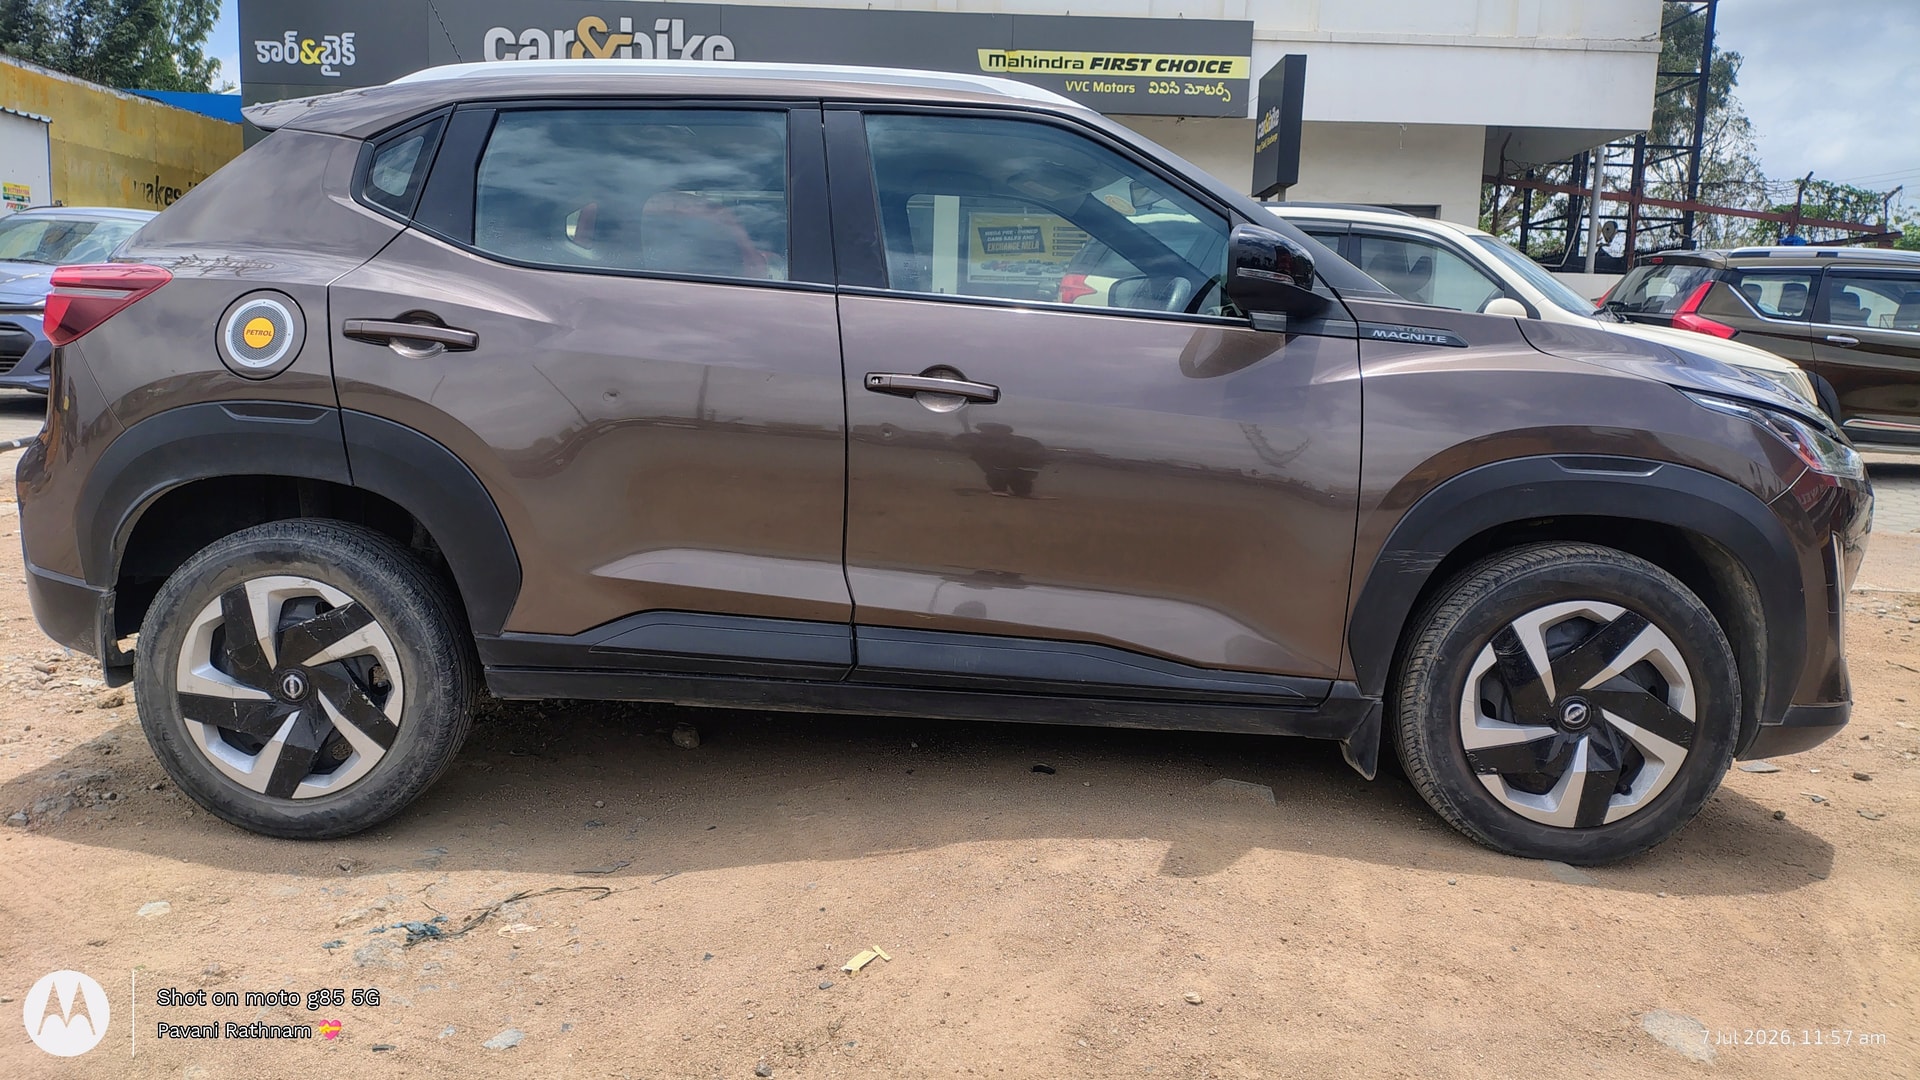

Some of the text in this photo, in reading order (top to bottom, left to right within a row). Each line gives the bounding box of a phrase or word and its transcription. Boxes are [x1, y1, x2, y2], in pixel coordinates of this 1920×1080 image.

[988, 54, 1233, 74] Mahindra FIRST CHOICE
[1065, 80, 1136, 93] VVC Motors
[245, 329, 273, 337] PETROL
[1372, 330, 1447, 343] MAGNITE
